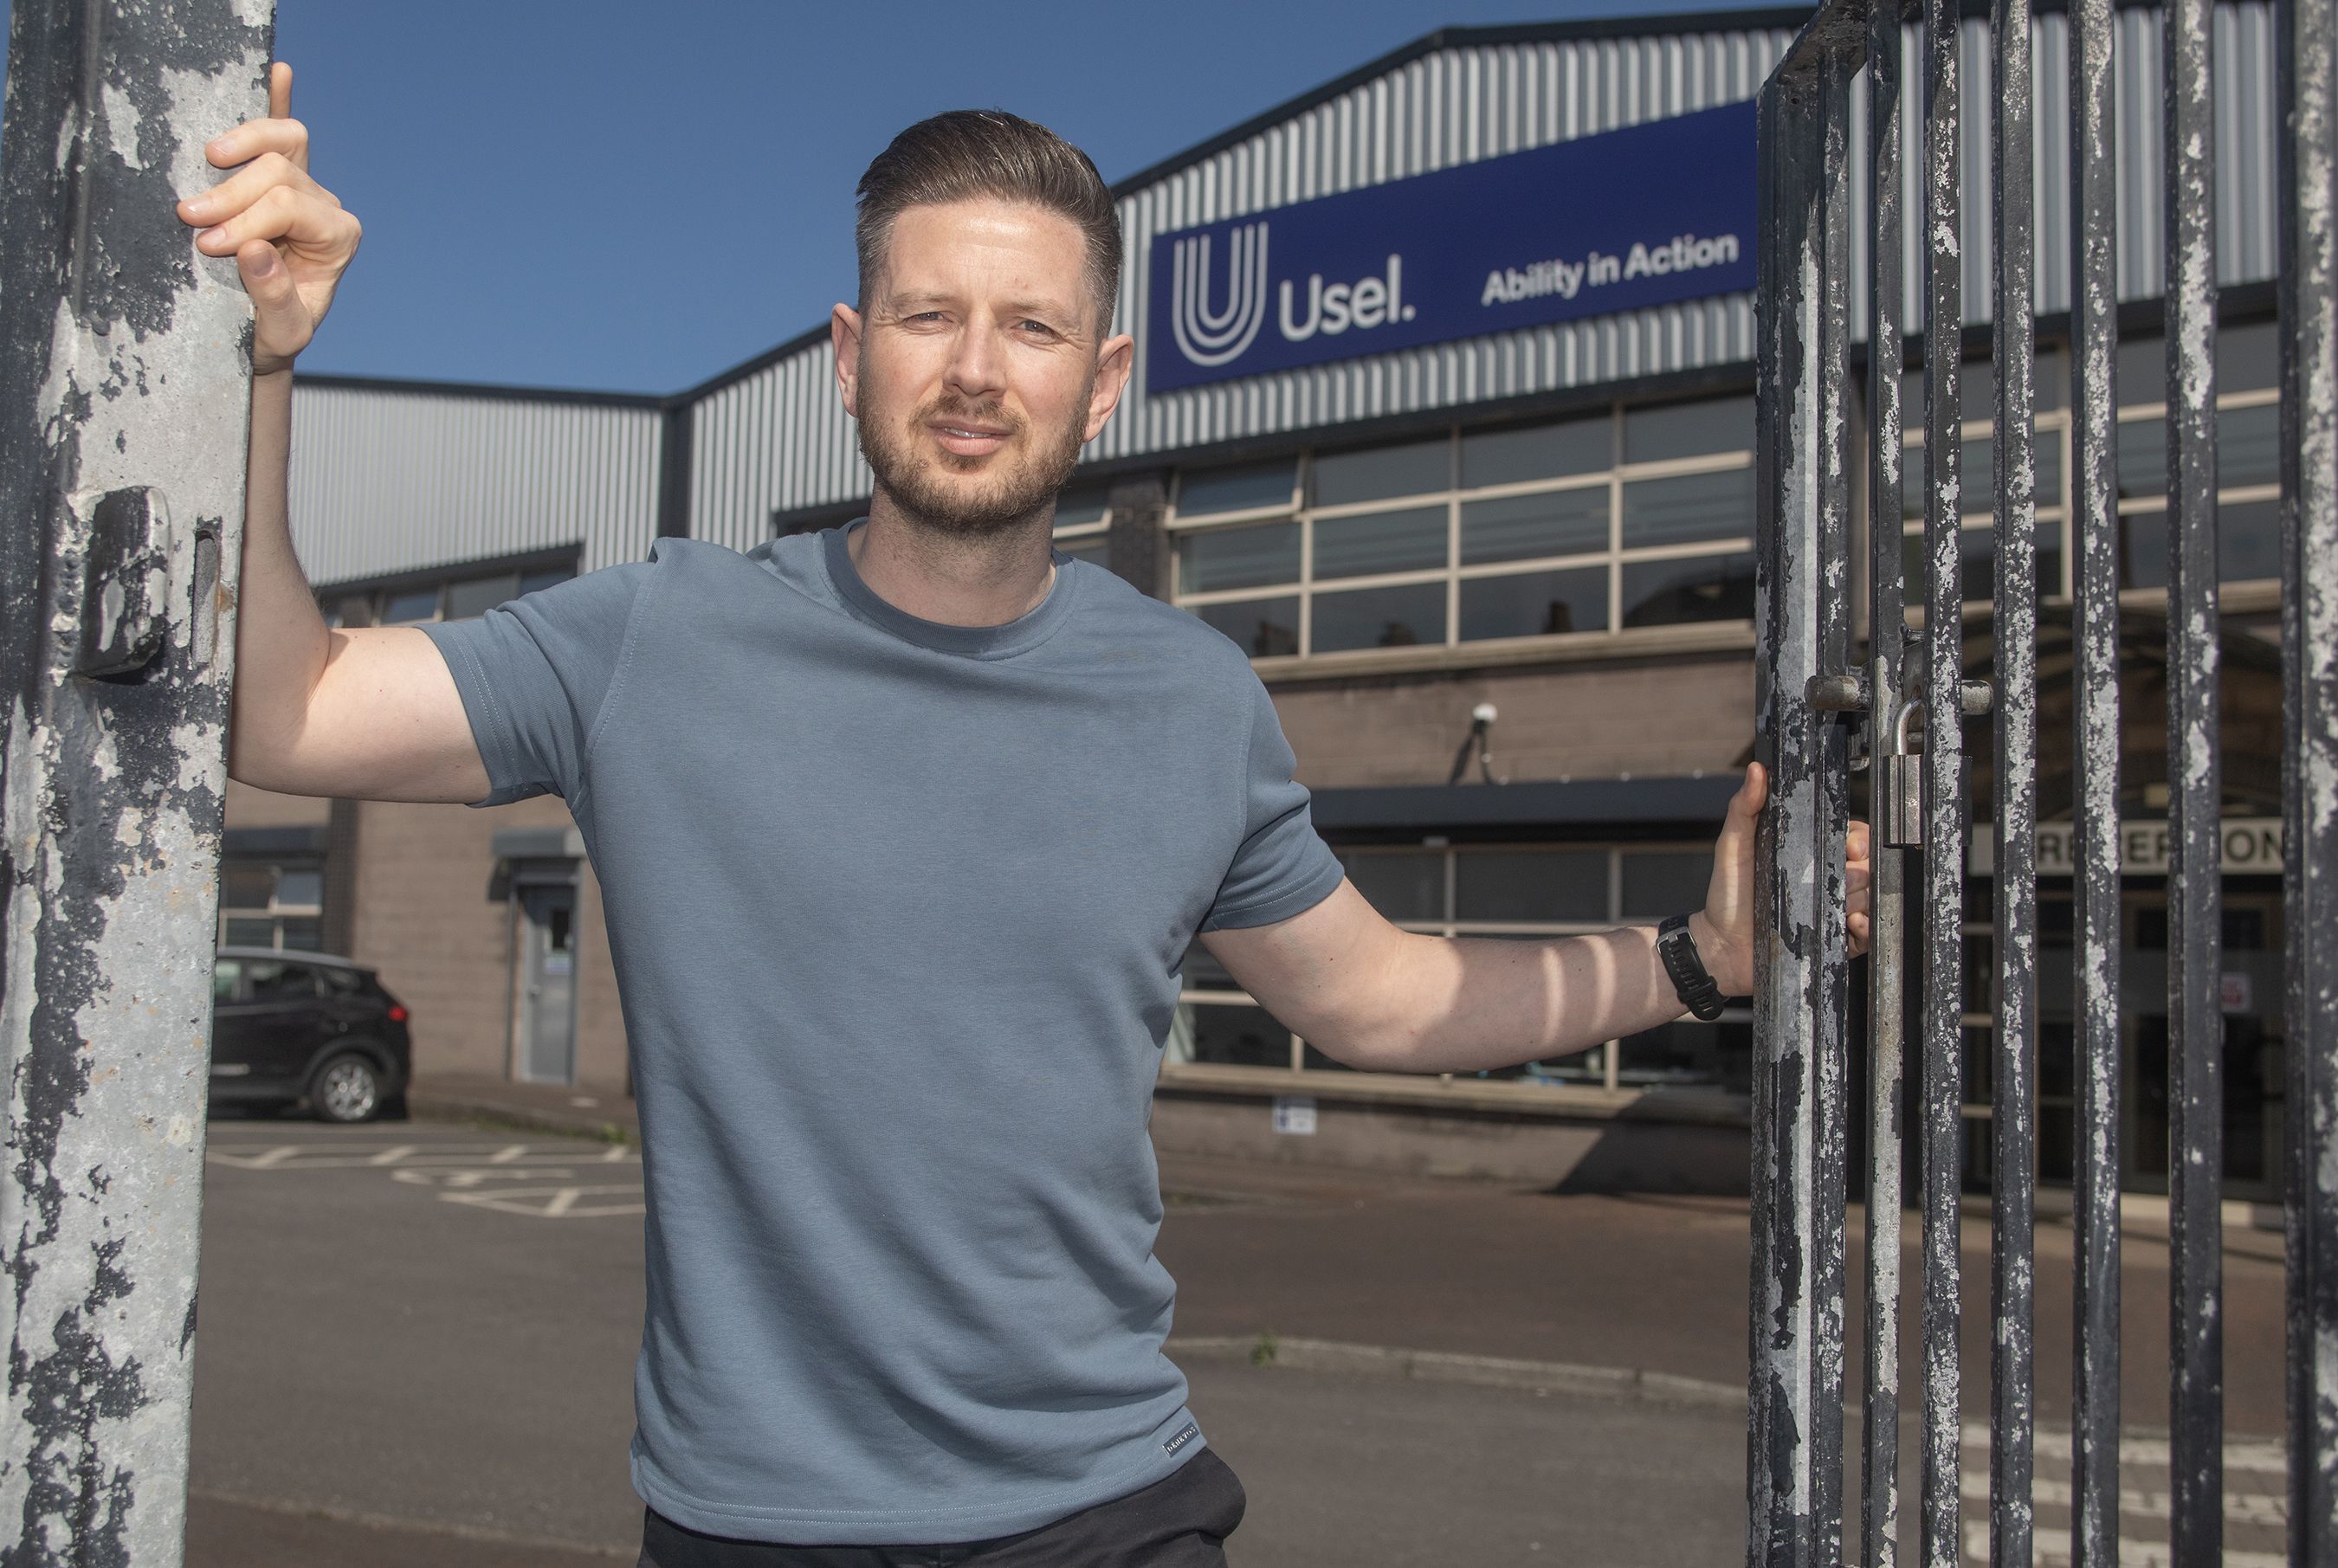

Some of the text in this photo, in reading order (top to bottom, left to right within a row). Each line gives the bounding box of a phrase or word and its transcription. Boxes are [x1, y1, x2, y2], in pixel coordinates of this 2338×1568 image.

[1279, 253, 1417, 342] Usel.
[1481, 233, 1740, 307] Ability in Action
